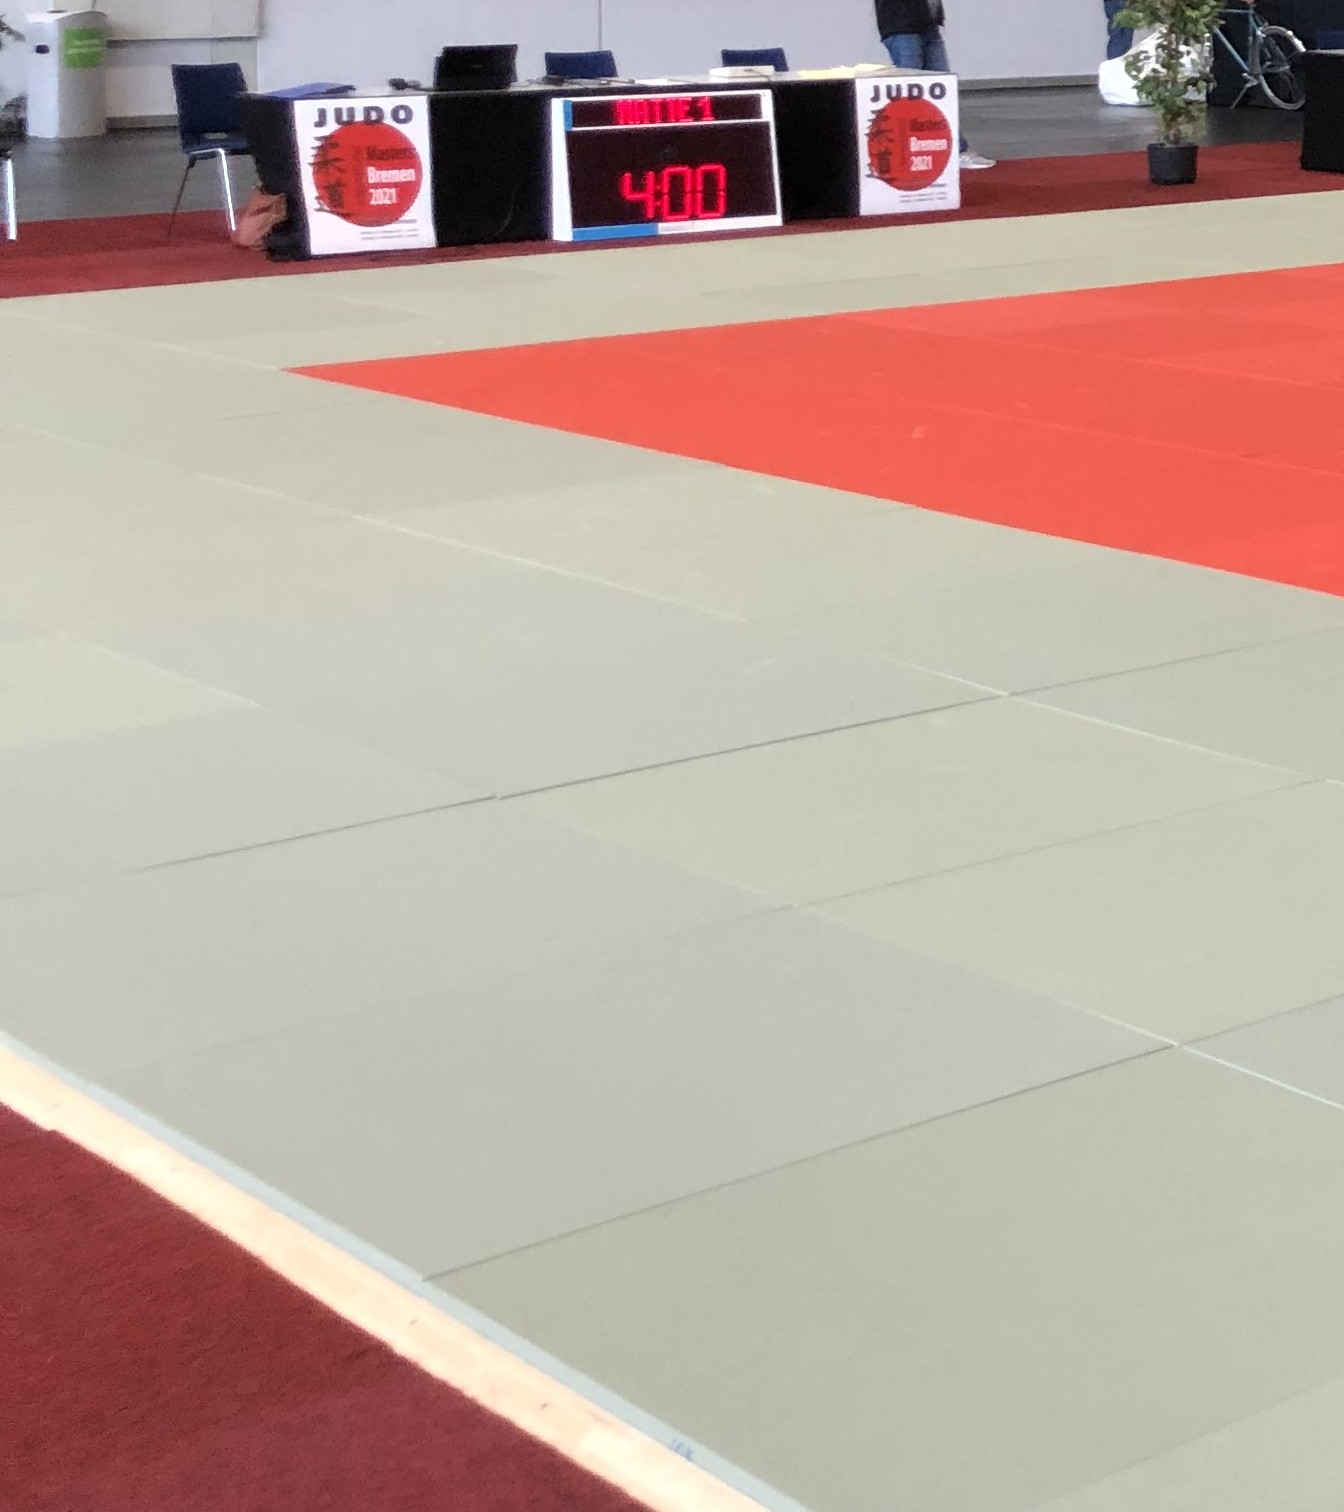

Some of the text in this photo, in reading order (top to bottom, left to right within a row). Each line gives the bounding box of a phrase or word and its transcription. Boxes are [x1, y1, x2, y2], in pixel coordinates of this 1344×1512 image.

[870, 82, 947, 103] JUDO
[313, 104, 414, 128] JUDO
[910, 137, 948, 151] Bremen
[910, 155, 932, 171] 2021
[367, 166, 416, 184] Bremen
[369, 187, 397, 205] 2021
[619, 163, 727, 222] 4:00
